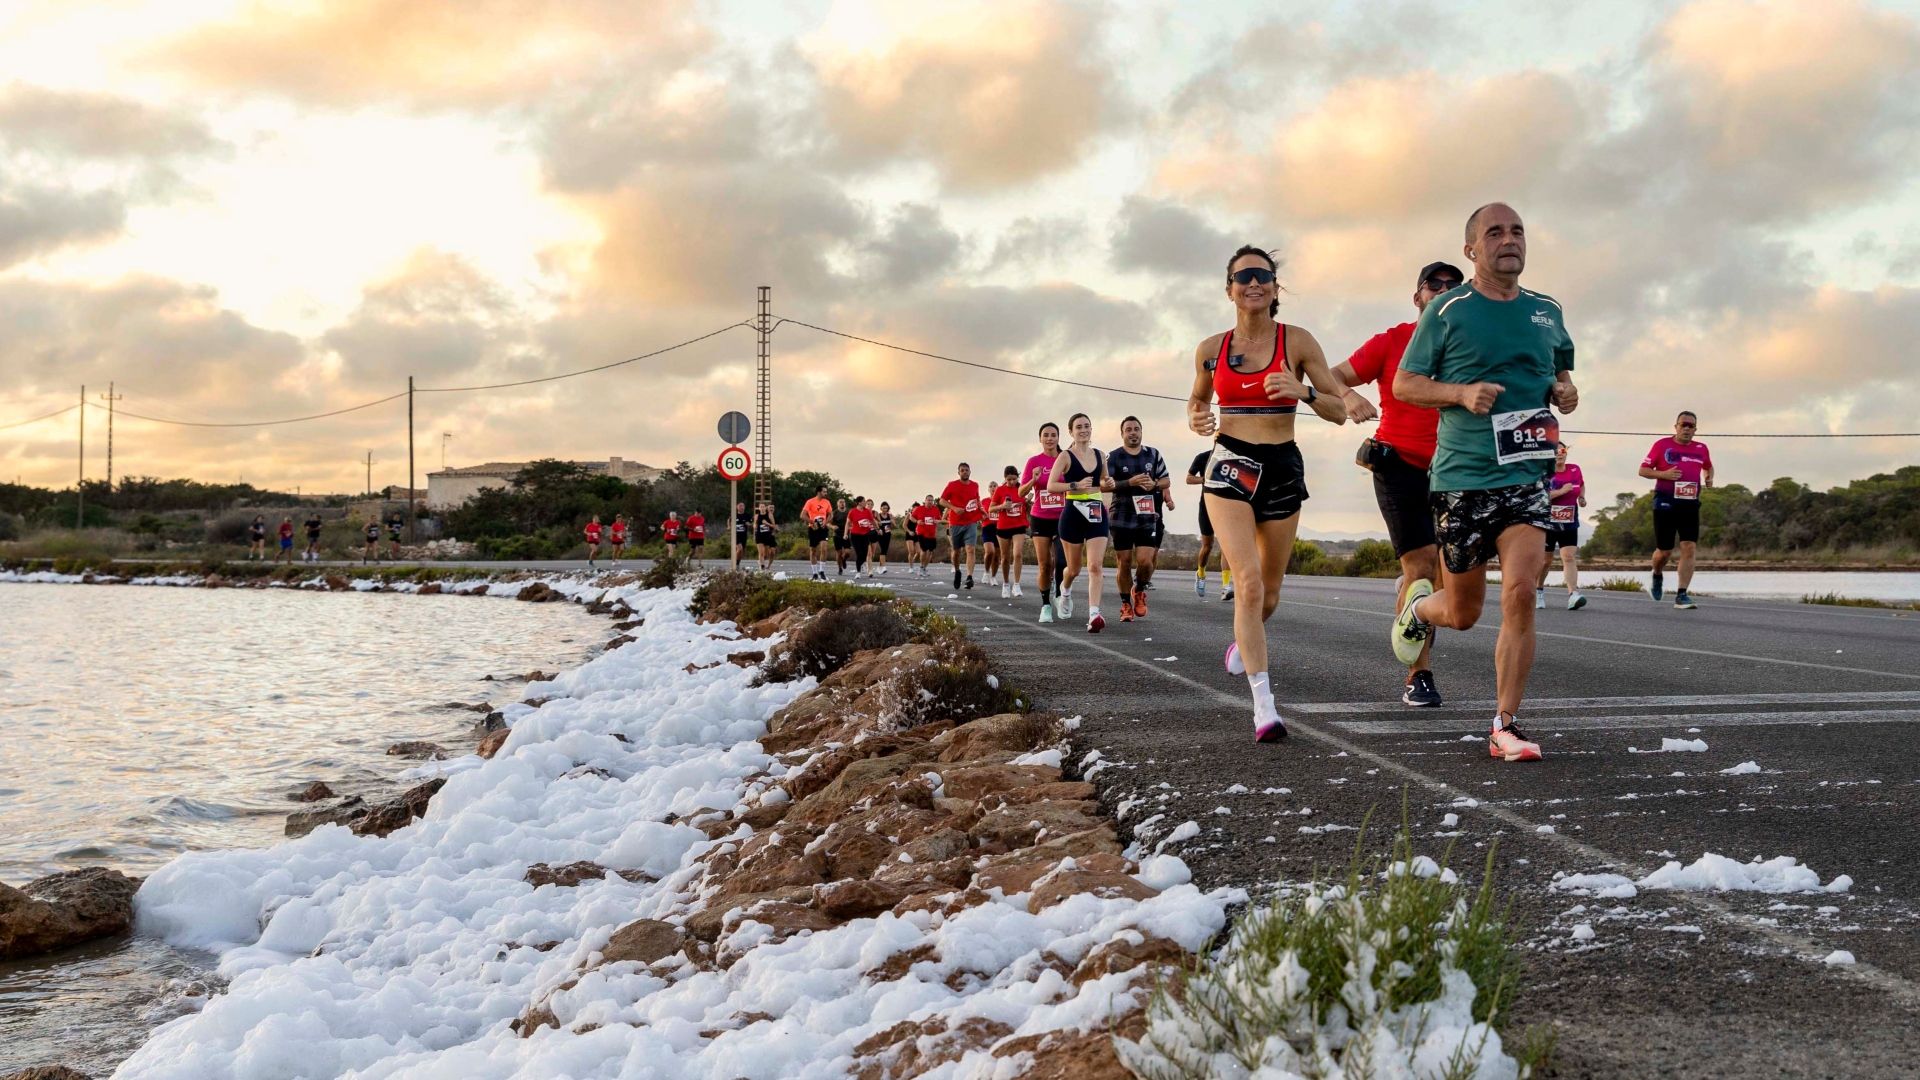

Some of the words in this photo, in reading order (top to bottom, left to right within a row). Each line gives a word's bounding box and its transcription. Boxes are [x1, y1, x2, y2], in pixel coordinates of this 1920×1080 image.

[1513, 428, 1547, 443] 812
[725, 457, 743, 470] 60
[1220, 464, 1239, 480] 98
